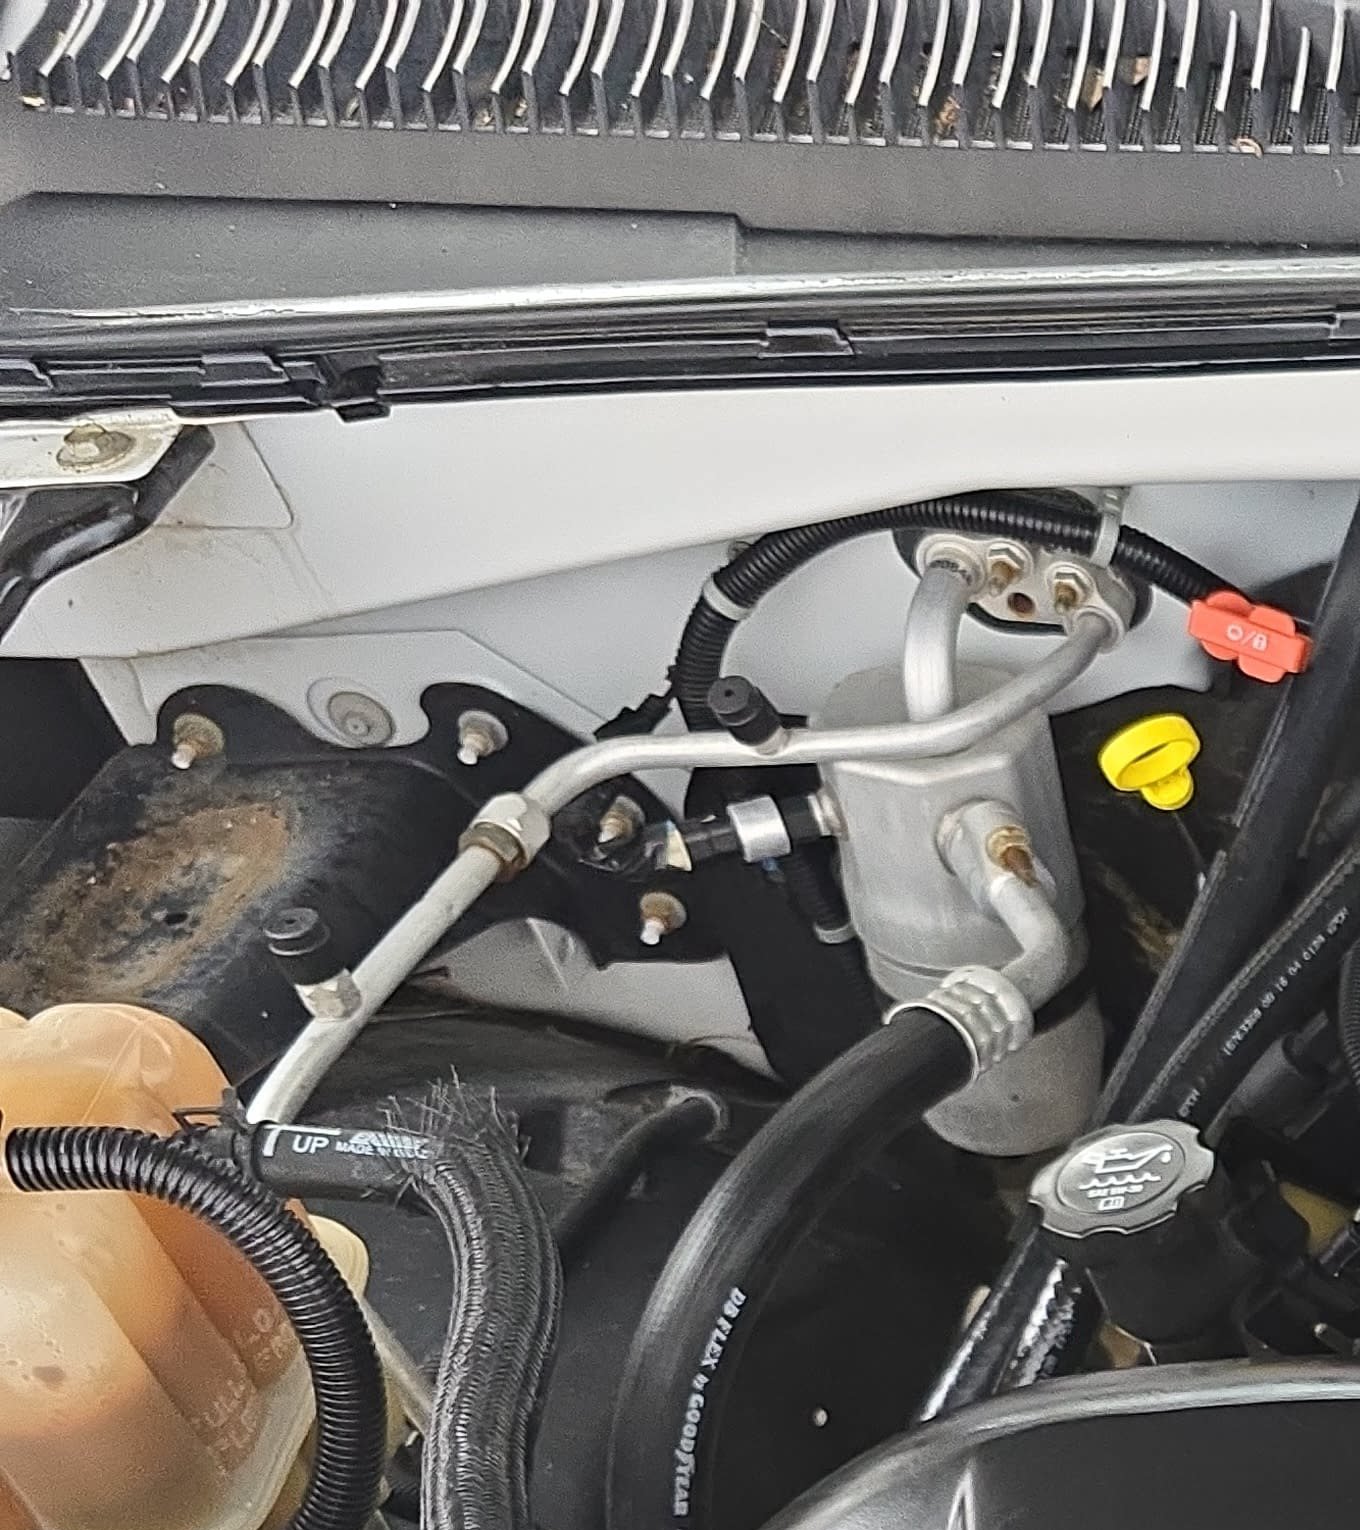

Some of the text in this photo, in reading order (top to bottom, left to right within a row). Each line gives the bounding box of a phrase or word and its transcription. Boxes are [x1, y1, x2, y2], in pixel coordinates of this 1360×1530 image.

[292, 1135, 330, 1154] UP
[723, 1286, 747, 1319] DB
[701, 1316, 733, 1370] FLEX
[673, 1393, 705, 1517] GOODYEAR
